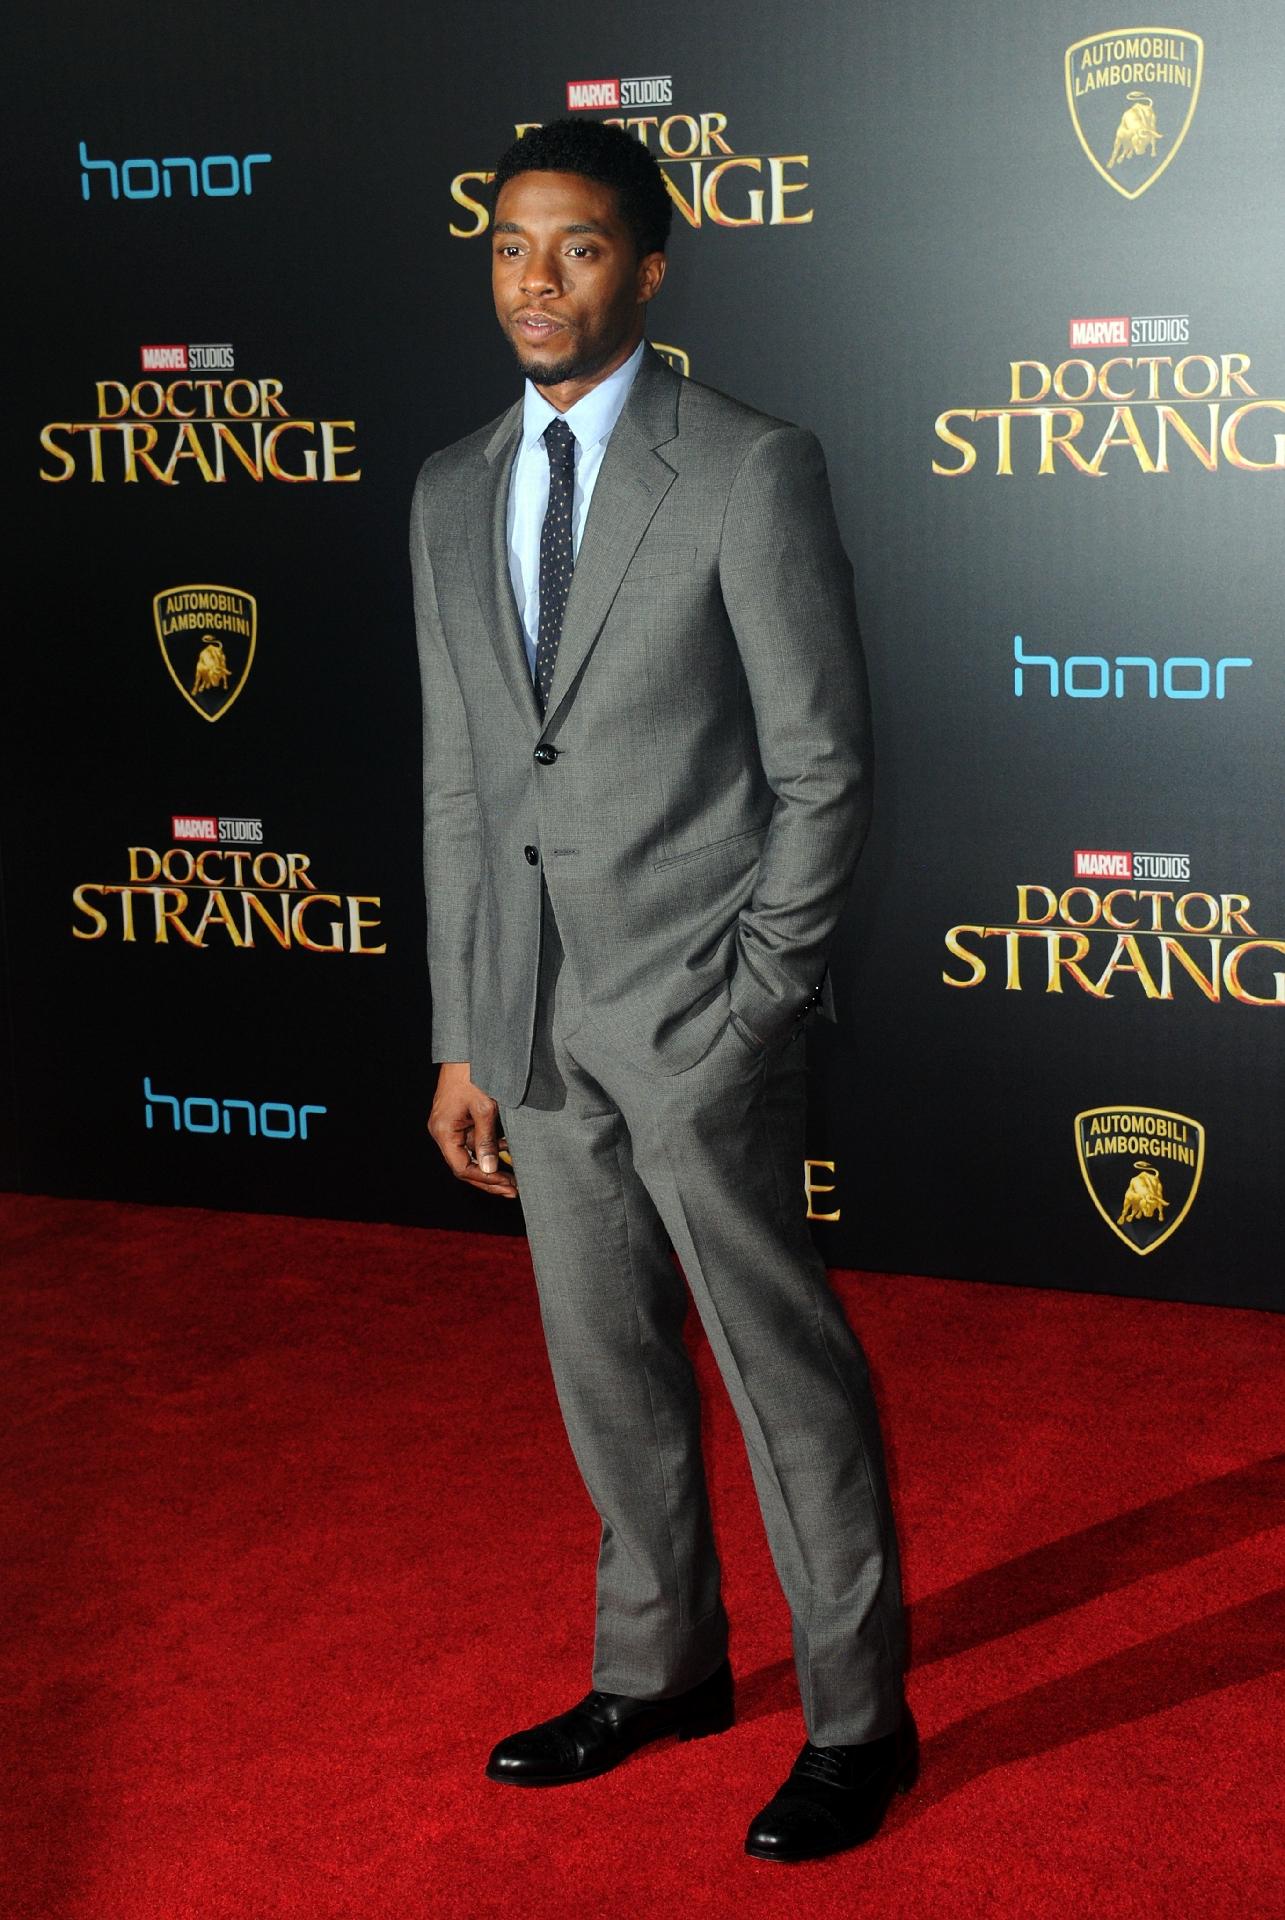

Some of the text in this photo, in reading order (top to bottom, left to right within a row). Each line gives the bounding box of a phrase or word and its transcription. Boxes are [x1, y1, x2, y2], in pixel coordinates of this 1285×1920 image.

[1081, 37, 1185, 70] AUTOMOBILI
[568, 79, 673, 108] MARVEL STUDIOS
[1075, 63, 1192, 97] LAMBORGHINI
[80, 141, 272, 200] honor
[1072, 318, 1189, 345] MARVEL STUDIOS
[143, 347, 235, 369] MARVEL STUDIOS
[1009, 353, 1259, 403] DOCTOR
[95, 378, 291, 419] DOCTOR
[39, 420, 362, 485] STRANGE
[166, 593, 243, 616] AUTOMOBILI
[162, 613, 250, 637] LAMBORGHINI
[1013, 634, 1253, 700] honor
[174, 818, 263, 841] MARVEL STUDIOS
[127, 847, 317, 890] DOCTOR
[1076, 853, 1191, 880] MARVEL STUDIOS
[72, 883, 387, 954] STRANGE
[1016, 885, 1259, 936] DOCTOR
[144, 1077, 327, 1139] honor
[1089, 1114, 1187, 1143] AUTOMOBILI
[1085, 1136, 1195, 1167] LAMBORGHINI
